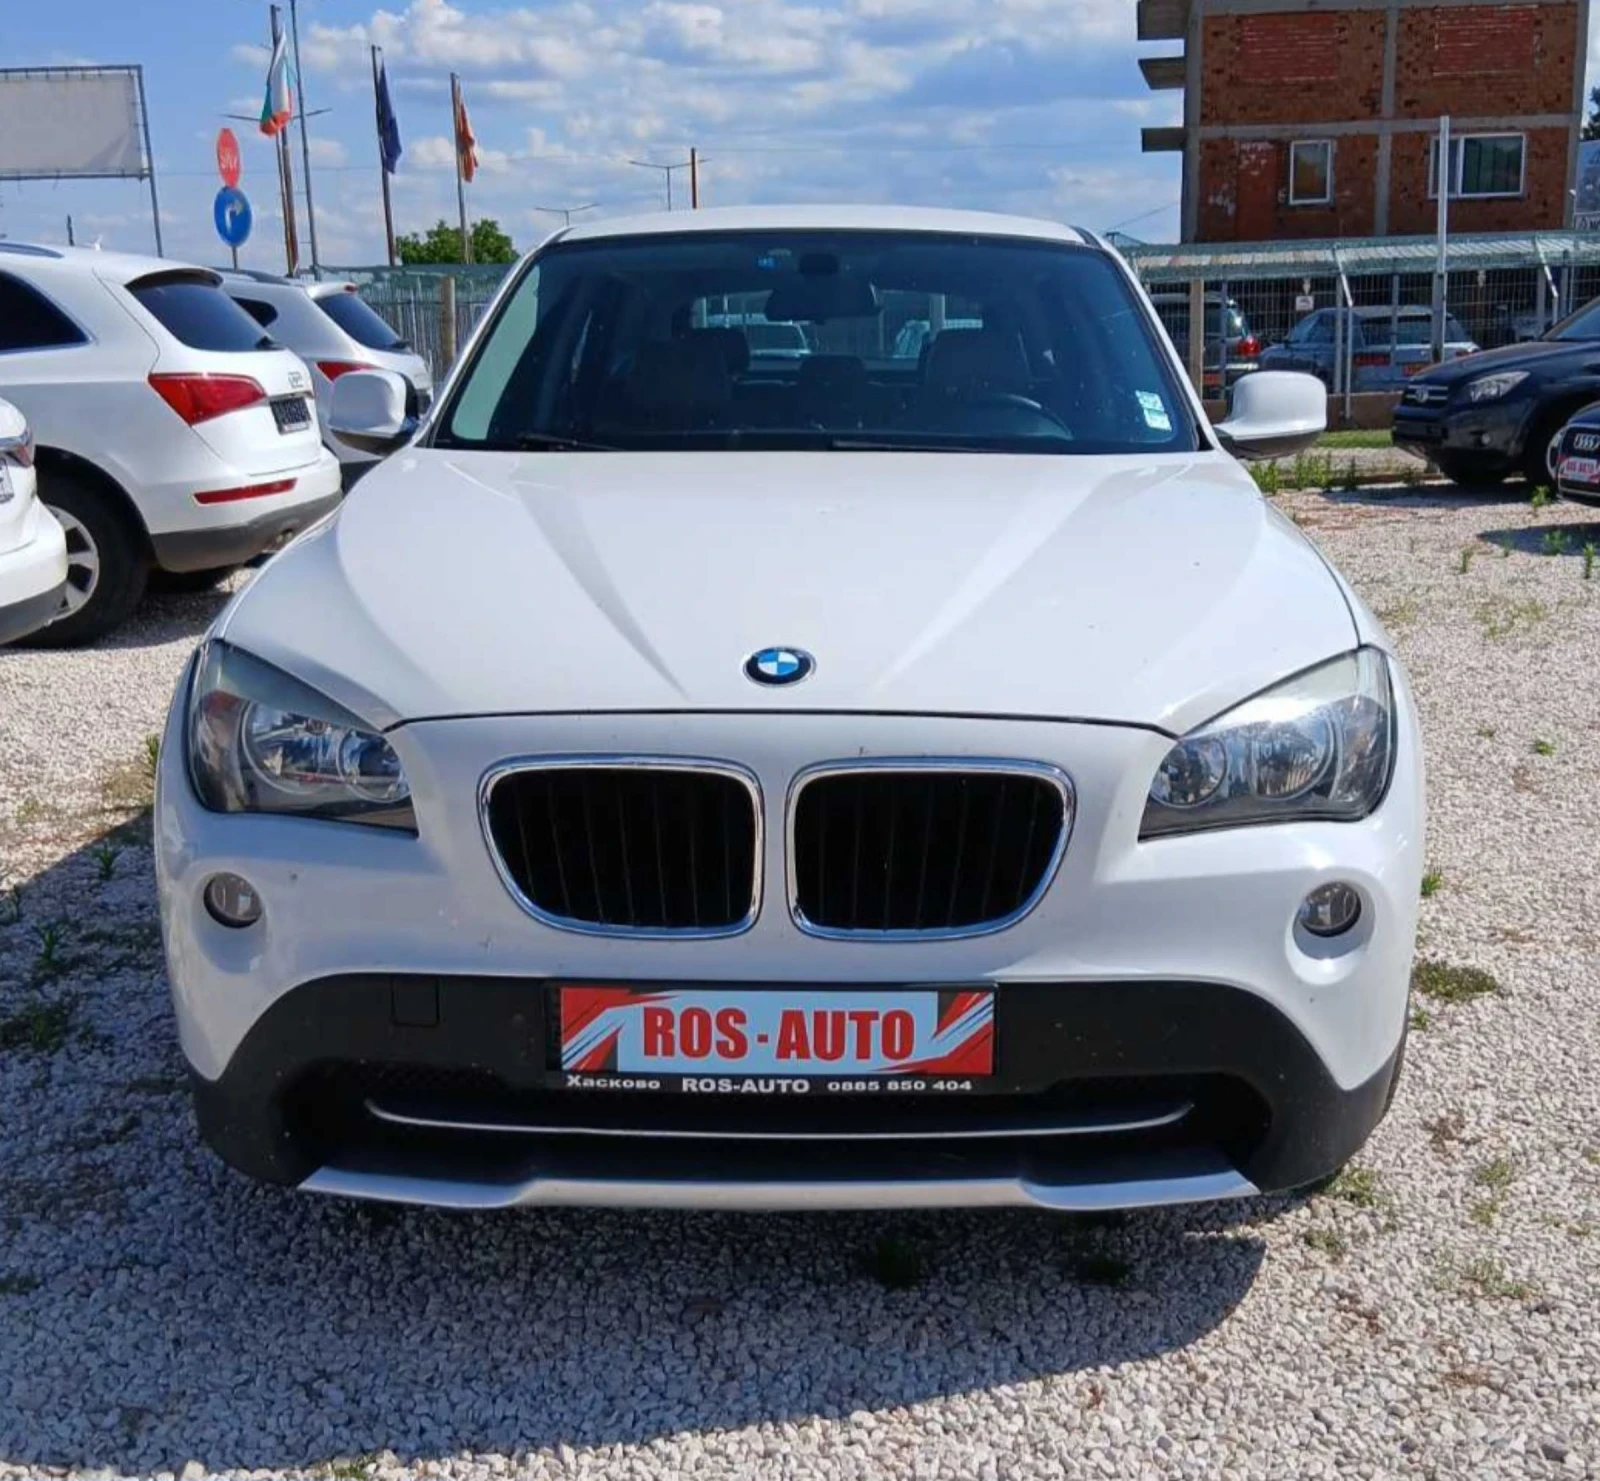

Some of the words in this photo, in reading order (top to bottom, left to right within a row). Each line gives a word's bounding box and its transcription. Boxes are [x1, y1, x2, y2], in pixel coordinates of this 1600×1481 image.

[566, 1074, 661, 1090] Хасково
[682, 1077, 811, 1093] ROS-AUTO
[827, 1081, 880, 1092] 0885
[887, 1080, 926, 1091] 850
[932, 1080, 972, 1091] 404
